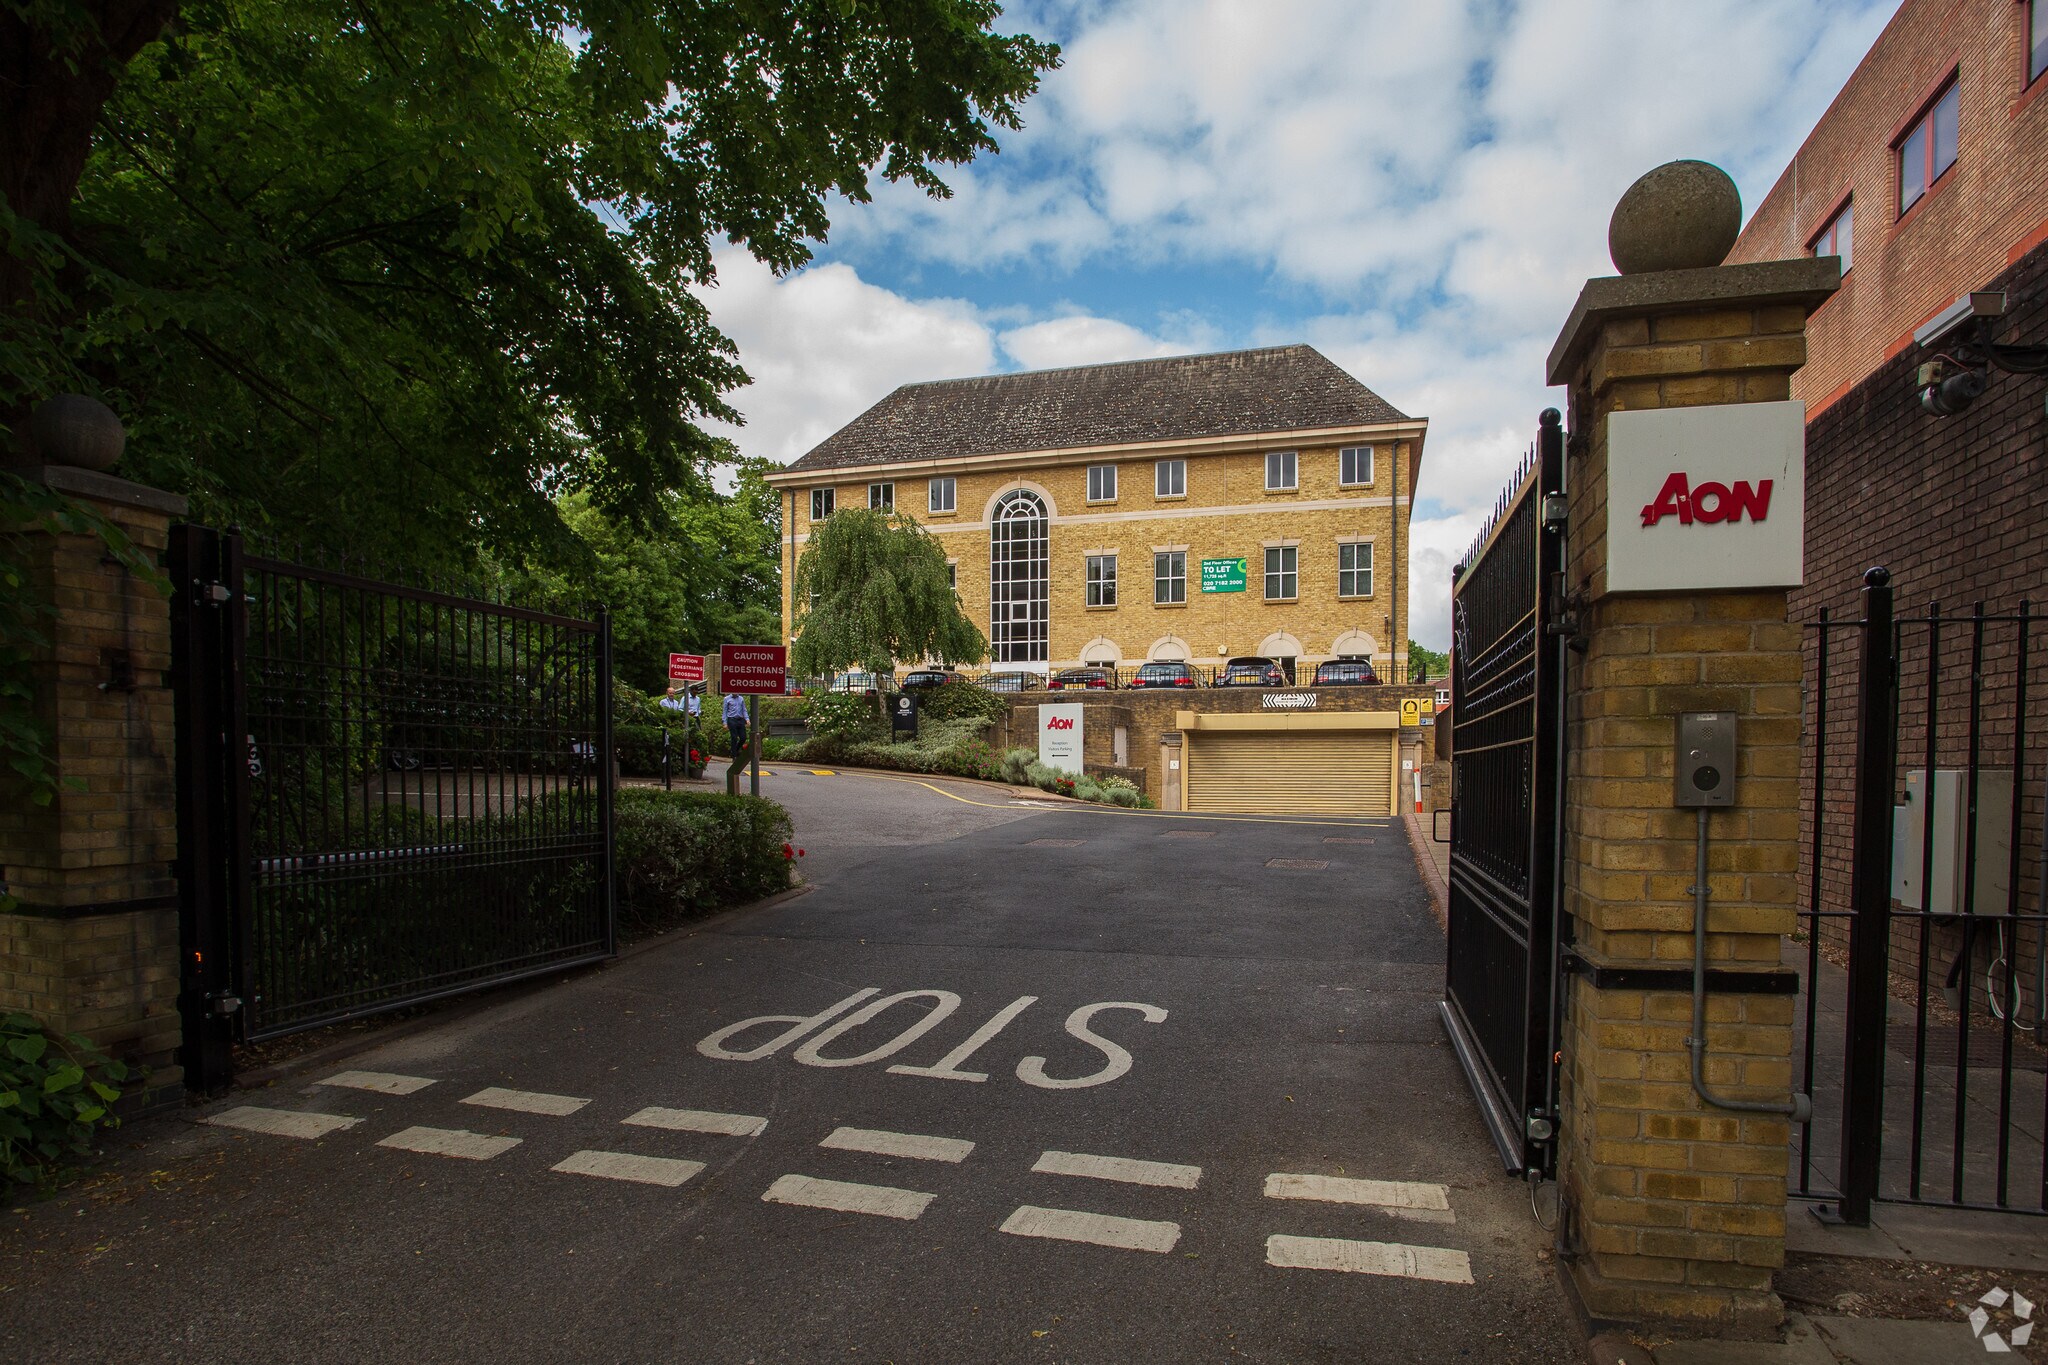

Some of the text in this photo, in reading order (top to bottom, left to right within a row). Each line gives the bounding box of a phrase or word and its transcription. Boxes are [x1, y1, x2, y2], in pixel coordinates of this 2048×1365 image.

[1216, 565, 1231, 573] LET
[733, 652, 774, 661] CAUTION
[671, 663, 703, 671] PEDESTRIANS
[723, 665, 784, 675] PEDESTRIANS
[729, 679, 777, 688] CROSSING
[695, 986, 1169, 1090] STOP
